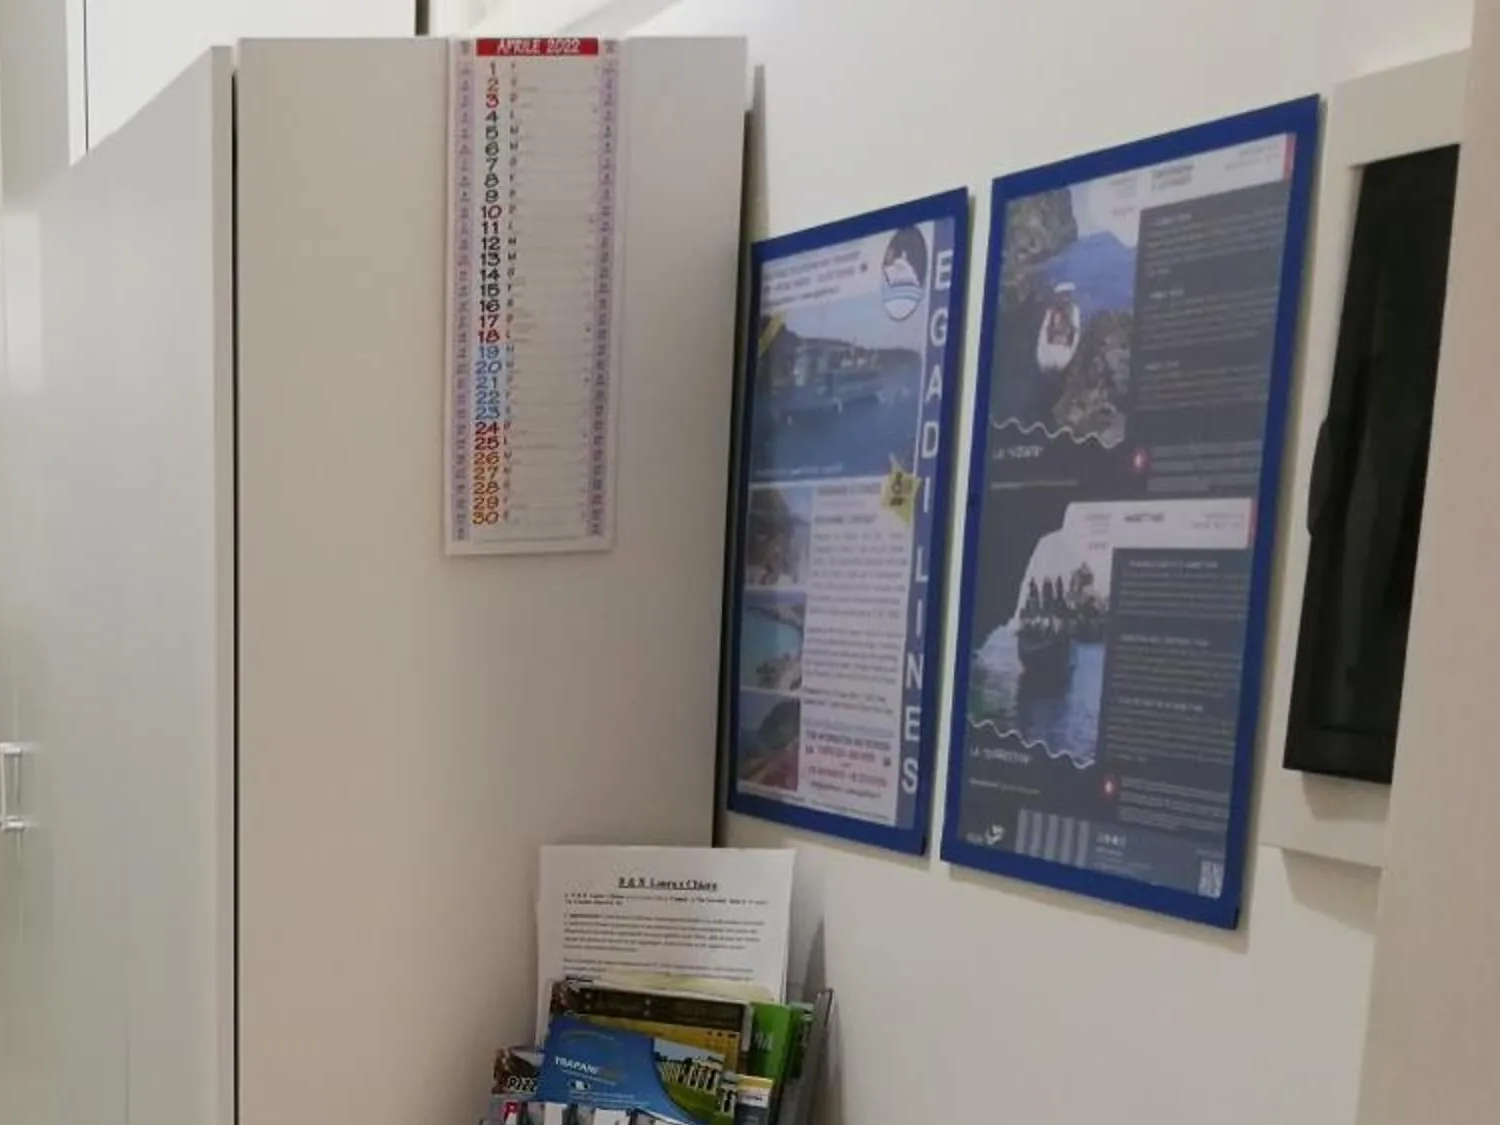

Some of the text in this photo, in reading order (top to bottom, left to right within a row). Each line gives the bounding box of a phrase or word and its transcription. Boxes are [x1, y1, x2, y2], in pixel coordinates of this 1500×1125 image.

[546, 37, 581, 54] 2022
[490, 62, 496, 75] 1
[487, 78, 499, 92] 2
[485, 94, 500, 108] 3
[485, 110, 498, 122] 4
[485, 126, 499, 140] 5
[485, 142, 499, 156] 6
[485, 157, 498, 172] 7
[484, 173, 499, 188] 8
[485, 189, 499, 203] 9
[481, 204, 502, 219] 10
[481, 221, 499, 235] 11
[481, 236, 501, 251] 12
[480, 252, 501, 267] 13
[480, 268, 501, 281] 14
[480, 283, 501, 297] 15
[479, 299, 501, 313] 16
[479, 314, 500, 328] 17
[478, 329, 501, 343] 18
[475, 361, 502, 374] 20
[475, 421, 501, 434] 24
[474, 436, 500, 450] 25
[474, 451, 500, 465] 26
[473, 466, 499, 480] 27
[473, 481, 500, 494] 28
[472, 511, 499, 525] 30
[901, 248, 954, 795] EGADI LINES
